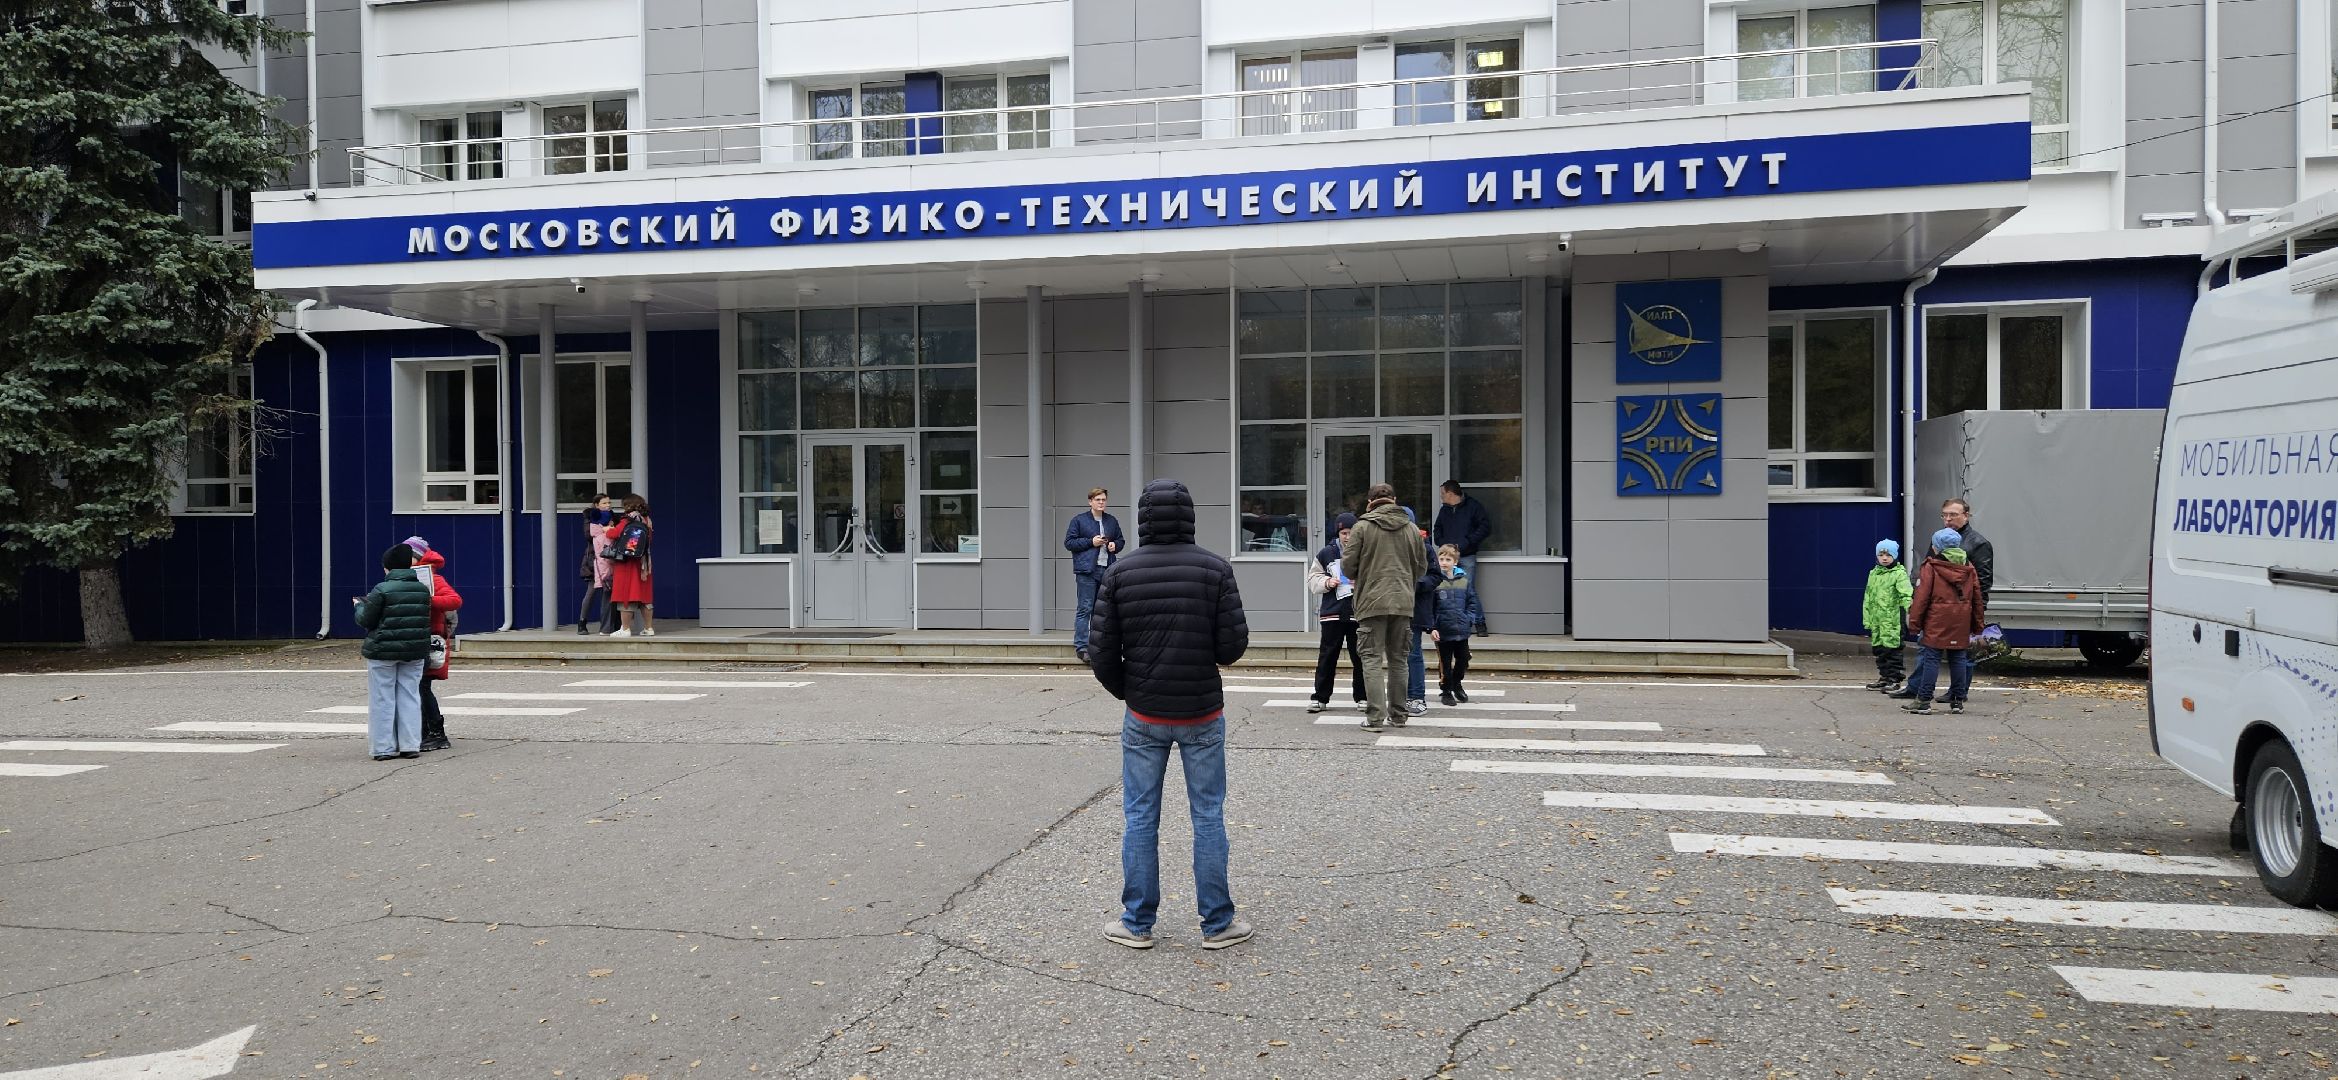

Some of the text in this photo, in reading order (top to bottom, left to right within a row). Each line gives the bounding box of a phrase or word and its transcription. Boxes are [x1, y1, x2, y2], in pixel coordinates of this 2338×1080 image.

[407, 152, 1787, 255] МОСКОВСКИЙ ФИЗИКО-ТЕХНИЧЕСКИЙ ИНСТИТУТ
[1646, 436, 1693, 453] РПИ
[2181, 433, 2338, 476] МОБИЛЬНАЯ
[2173, 499, 2337, 541] ЛАБОРАТОРИЯ
